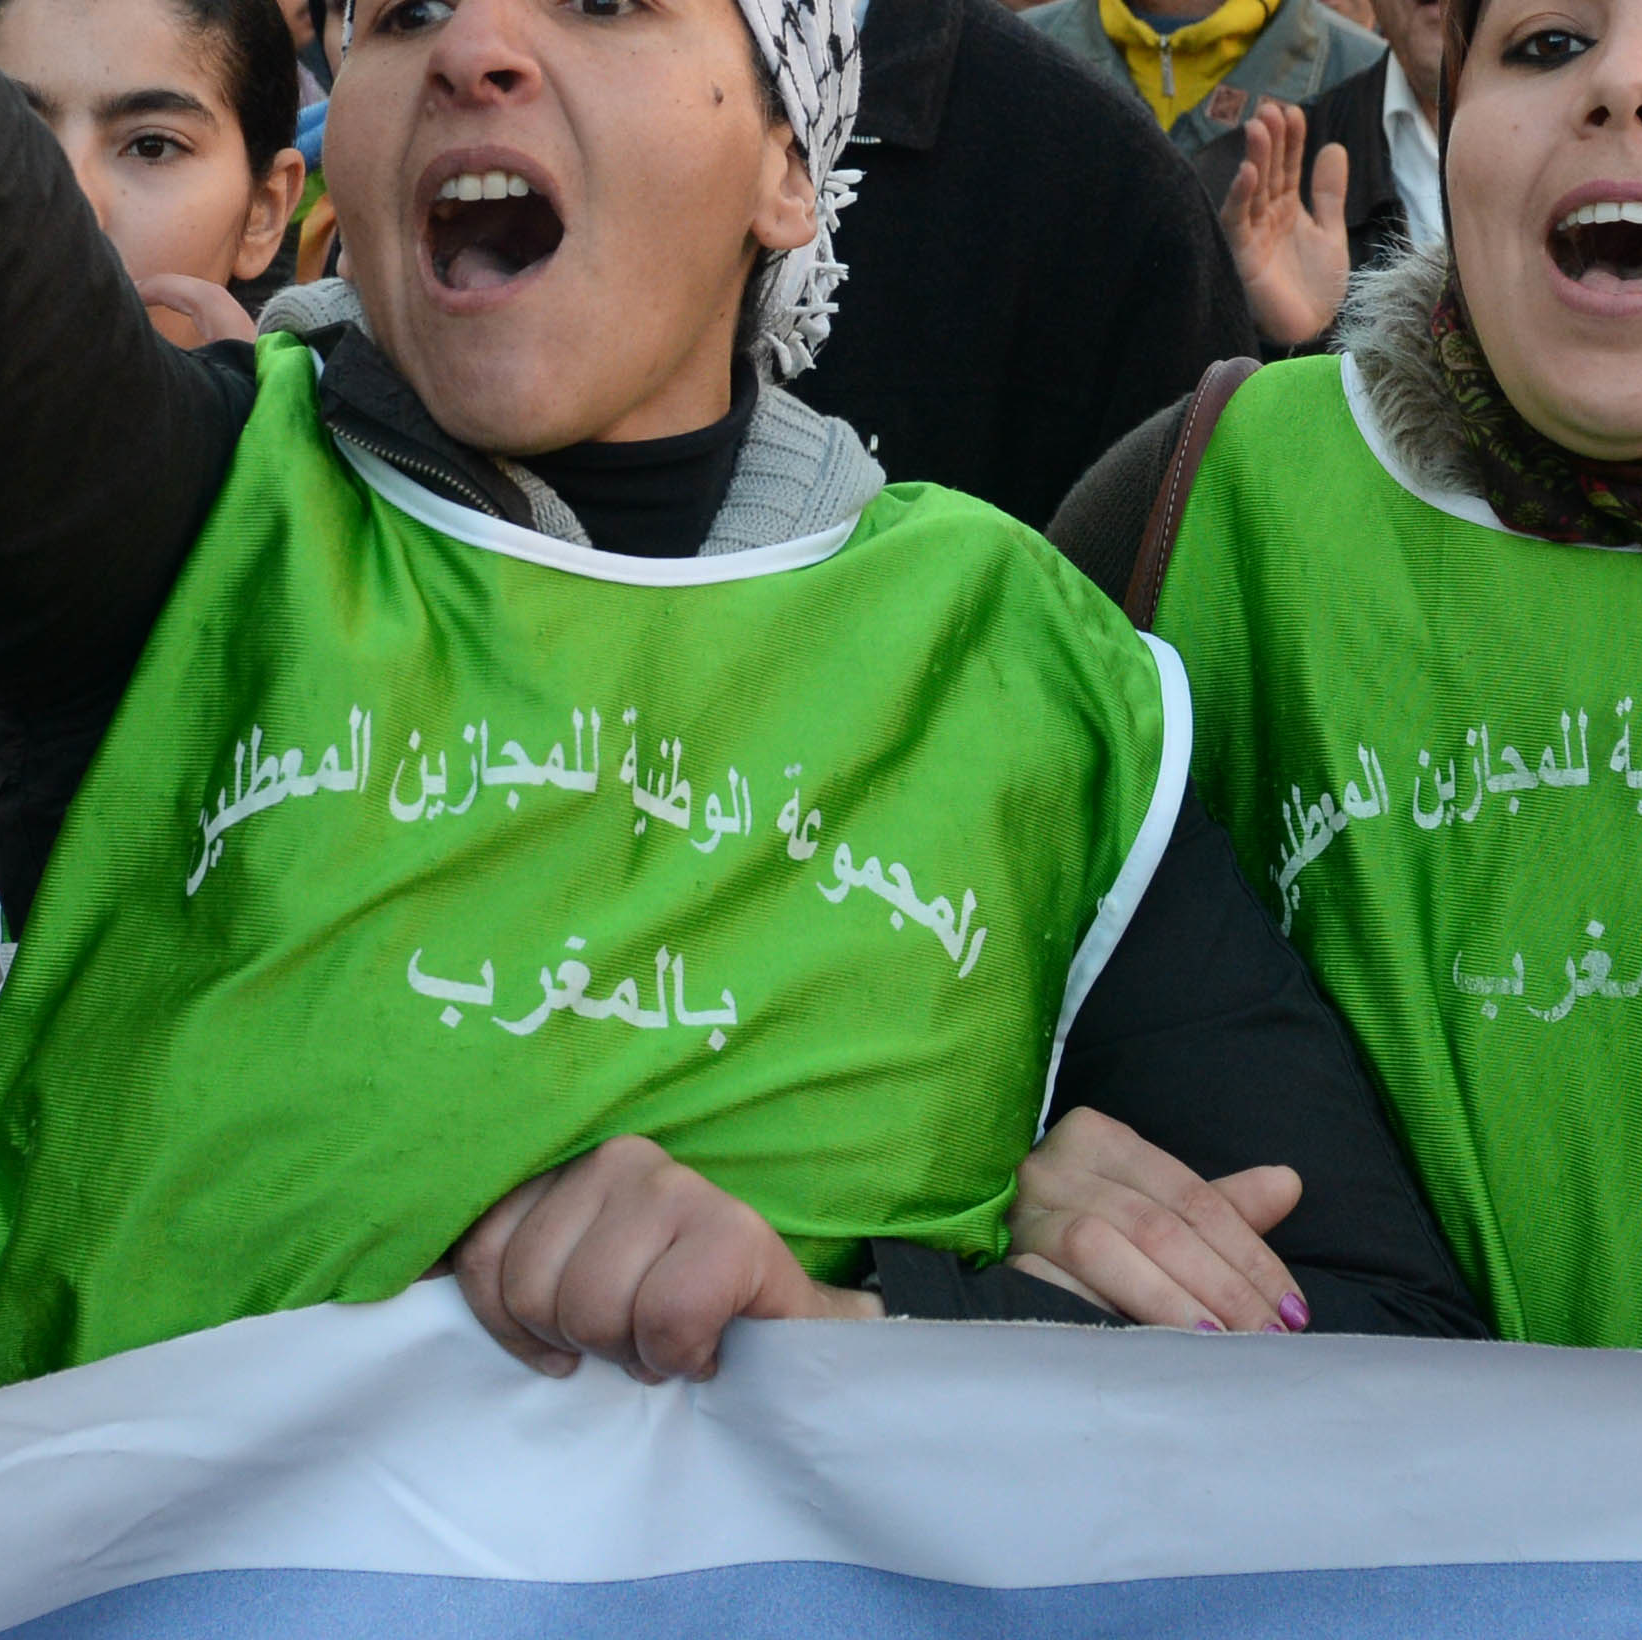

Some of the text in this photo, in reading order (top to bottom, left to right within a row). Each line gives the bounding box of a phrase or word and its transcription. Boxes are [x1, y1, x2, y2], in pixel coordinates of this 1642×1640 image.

[388, 705, 600, 824] للمجازين
[617, 706, 752, 855] الوطنية
[1412, 707, 1590, 830] للمجازين
[775, 760, 987, 978] المجموعة
[406, 933, 738, 1052] بالمغرب
